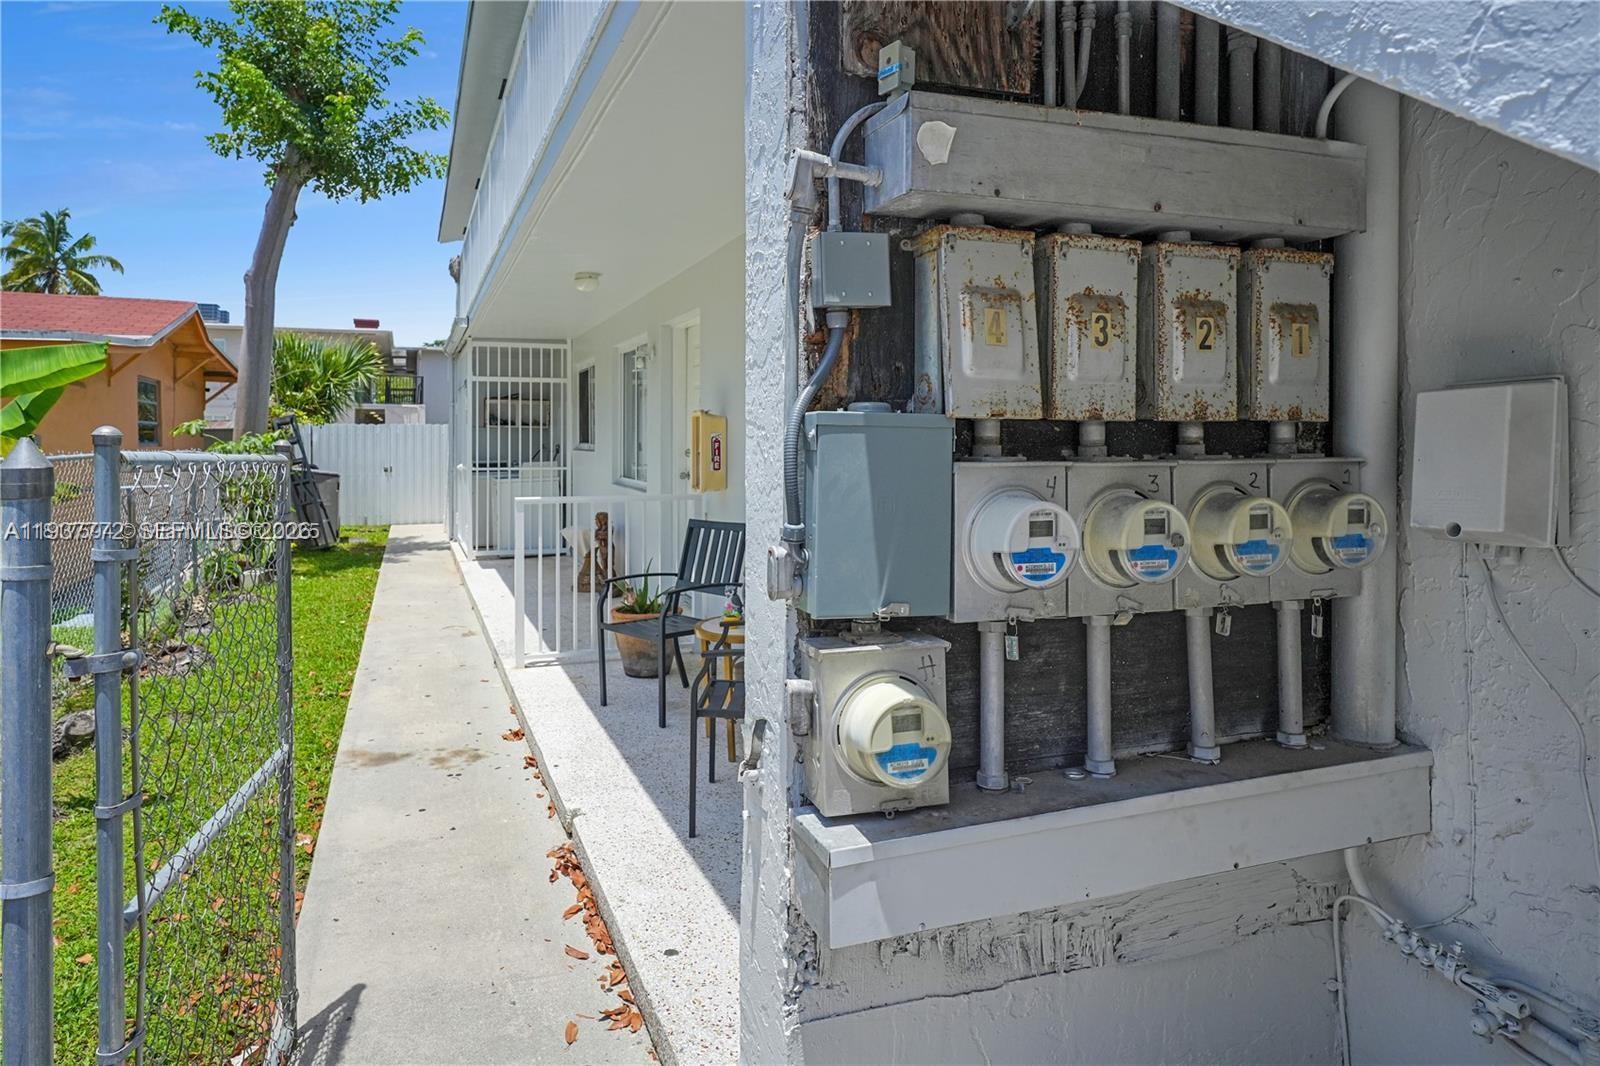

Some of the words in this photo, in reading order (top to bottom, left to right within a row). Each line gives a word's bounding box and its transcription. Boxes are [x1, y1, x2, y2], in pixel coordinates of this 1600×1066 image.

[1094, 314, 1109, 347] 3
[1198, 319, 1213, 350] 2
[1295, 325, 1304, 354] 1
[713, 442, 721, 469] FIRE
[1046, 475, 1057, 498] 4
[1147, 474, 1159, 494] 3
[1248, 471, 1260, 489] 2
[1341, 468, 1352, 486] 1
